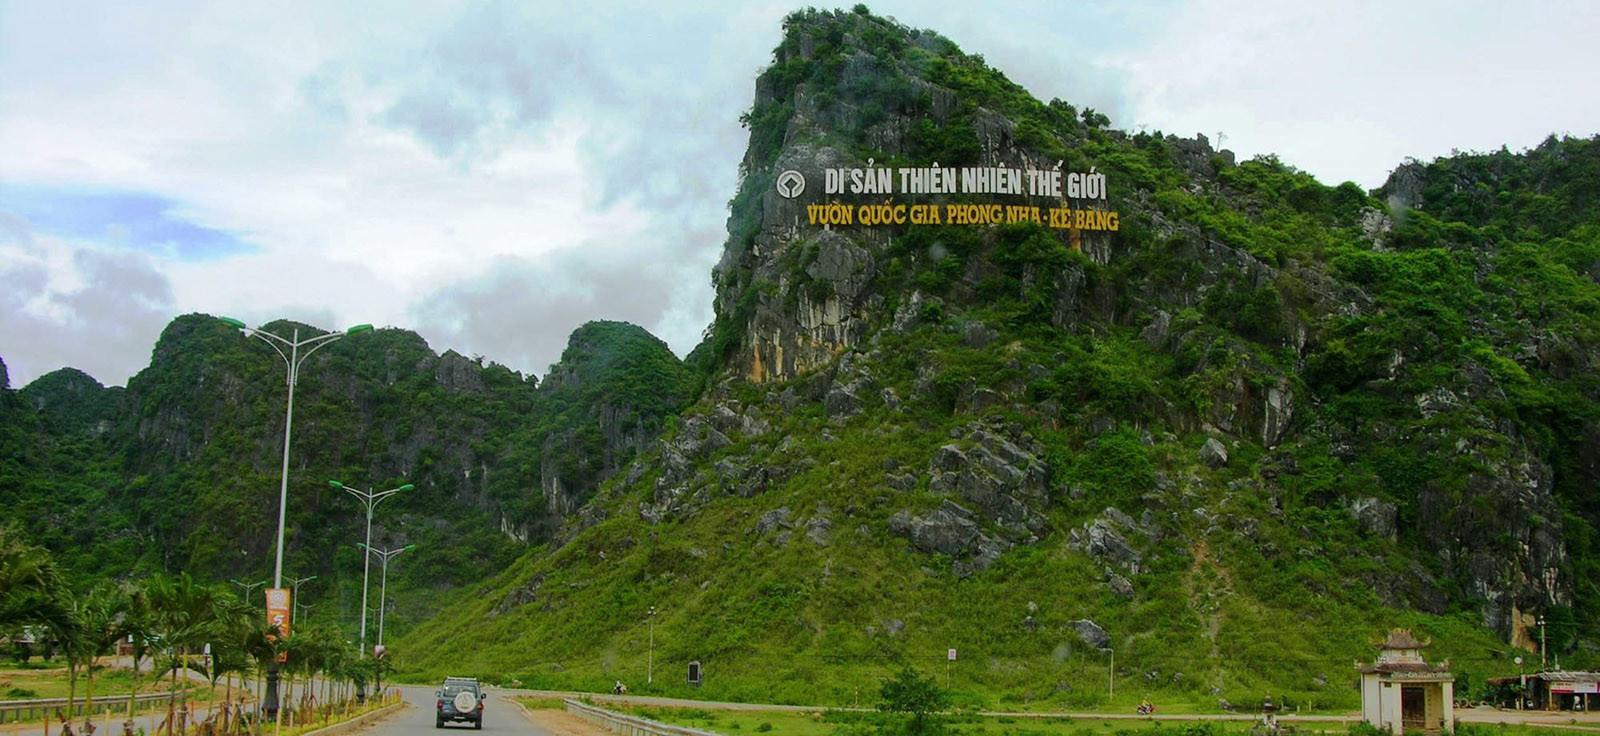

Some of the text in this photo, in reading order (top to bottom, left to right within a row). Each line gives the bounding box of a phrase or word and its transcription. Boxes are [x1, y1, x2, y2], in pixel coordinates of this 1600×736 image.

[825, 158, 1107, 200] DI SẢN THIÊN NHIÊN THẾ GIỚI
[807, 200, 854, 225] VƯỜN
[858, 197, 907, 226] QUỐC
[910, 204, 942, 225] GIA
[946, 204, 1004, 225] PHONG
[1075, 206, 1120, 232] BÀNG
